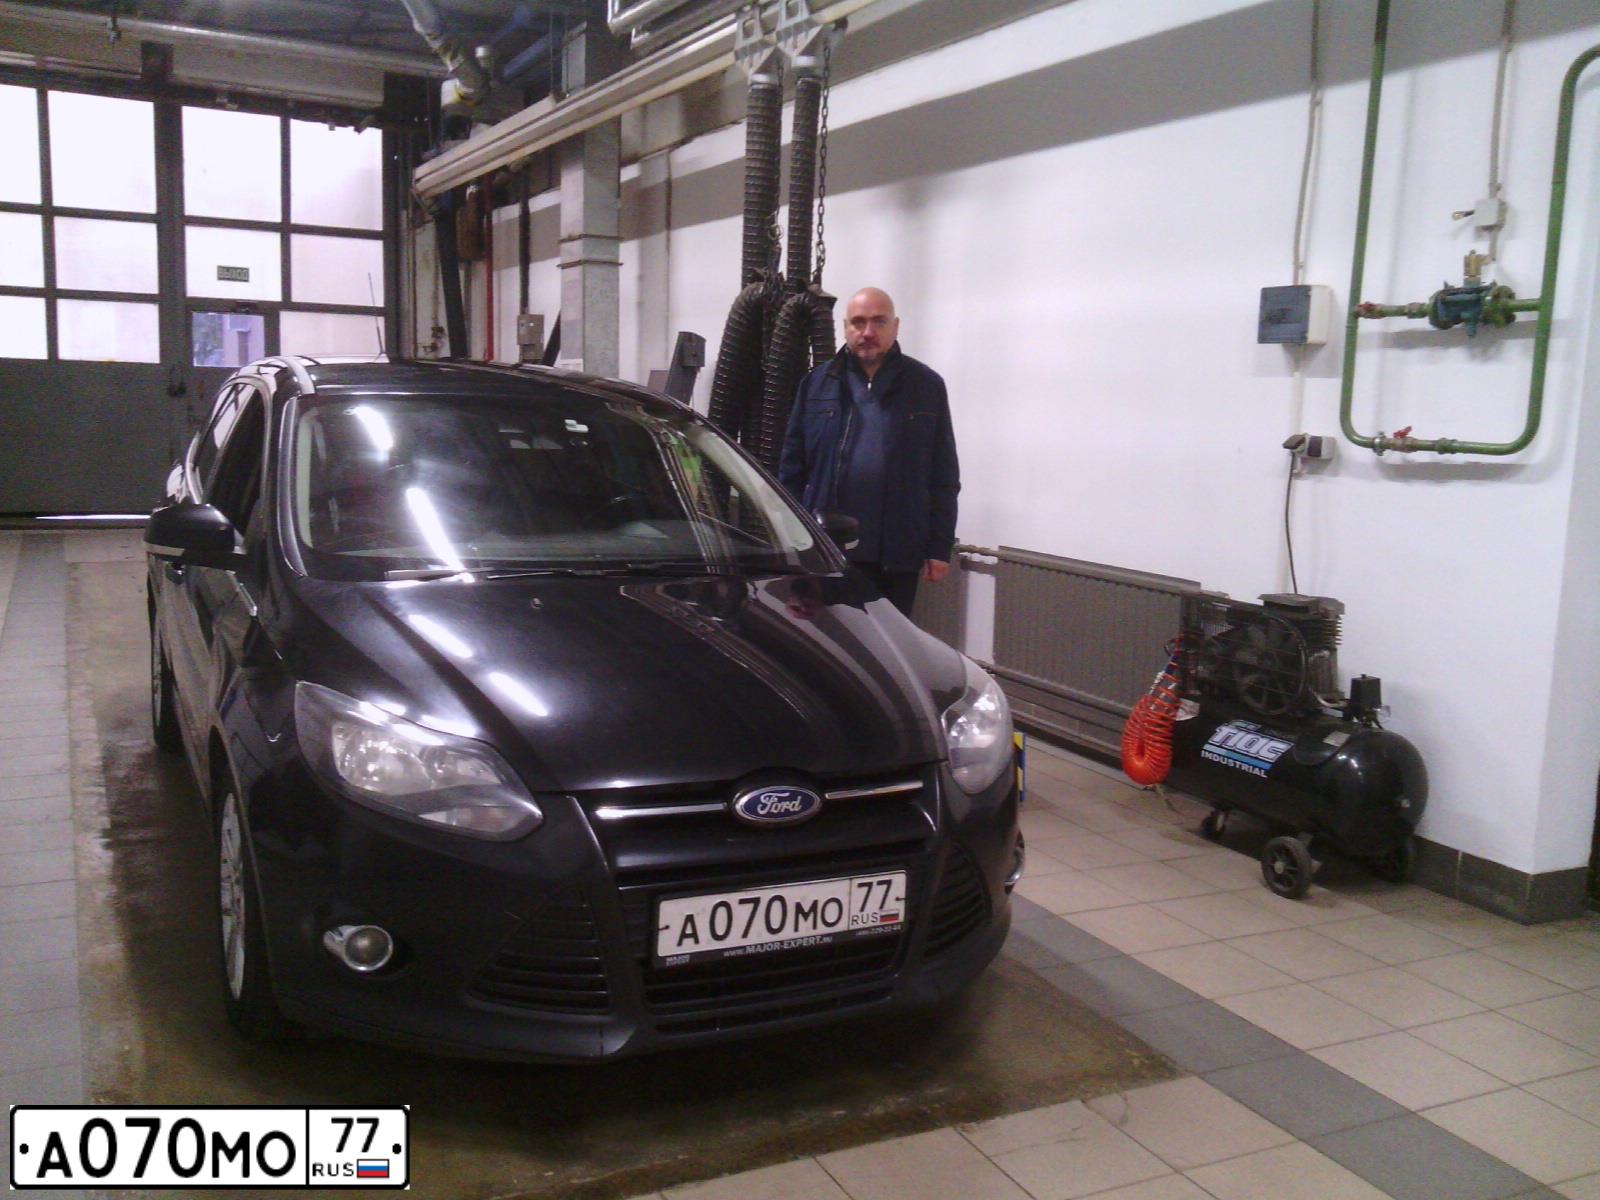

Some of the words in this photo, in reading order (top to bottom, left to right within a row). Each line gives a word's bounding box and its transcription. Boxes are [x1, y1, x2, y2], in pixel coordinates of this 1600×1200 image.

[1201, 750, 1268, 778] INDUSTRIAL
[757, 792, 802, 814] Ford
[676, 894, 844, 947] A070MO
[857, 879, 893, 912] 77
[851, 912, 879, 925] RUS
